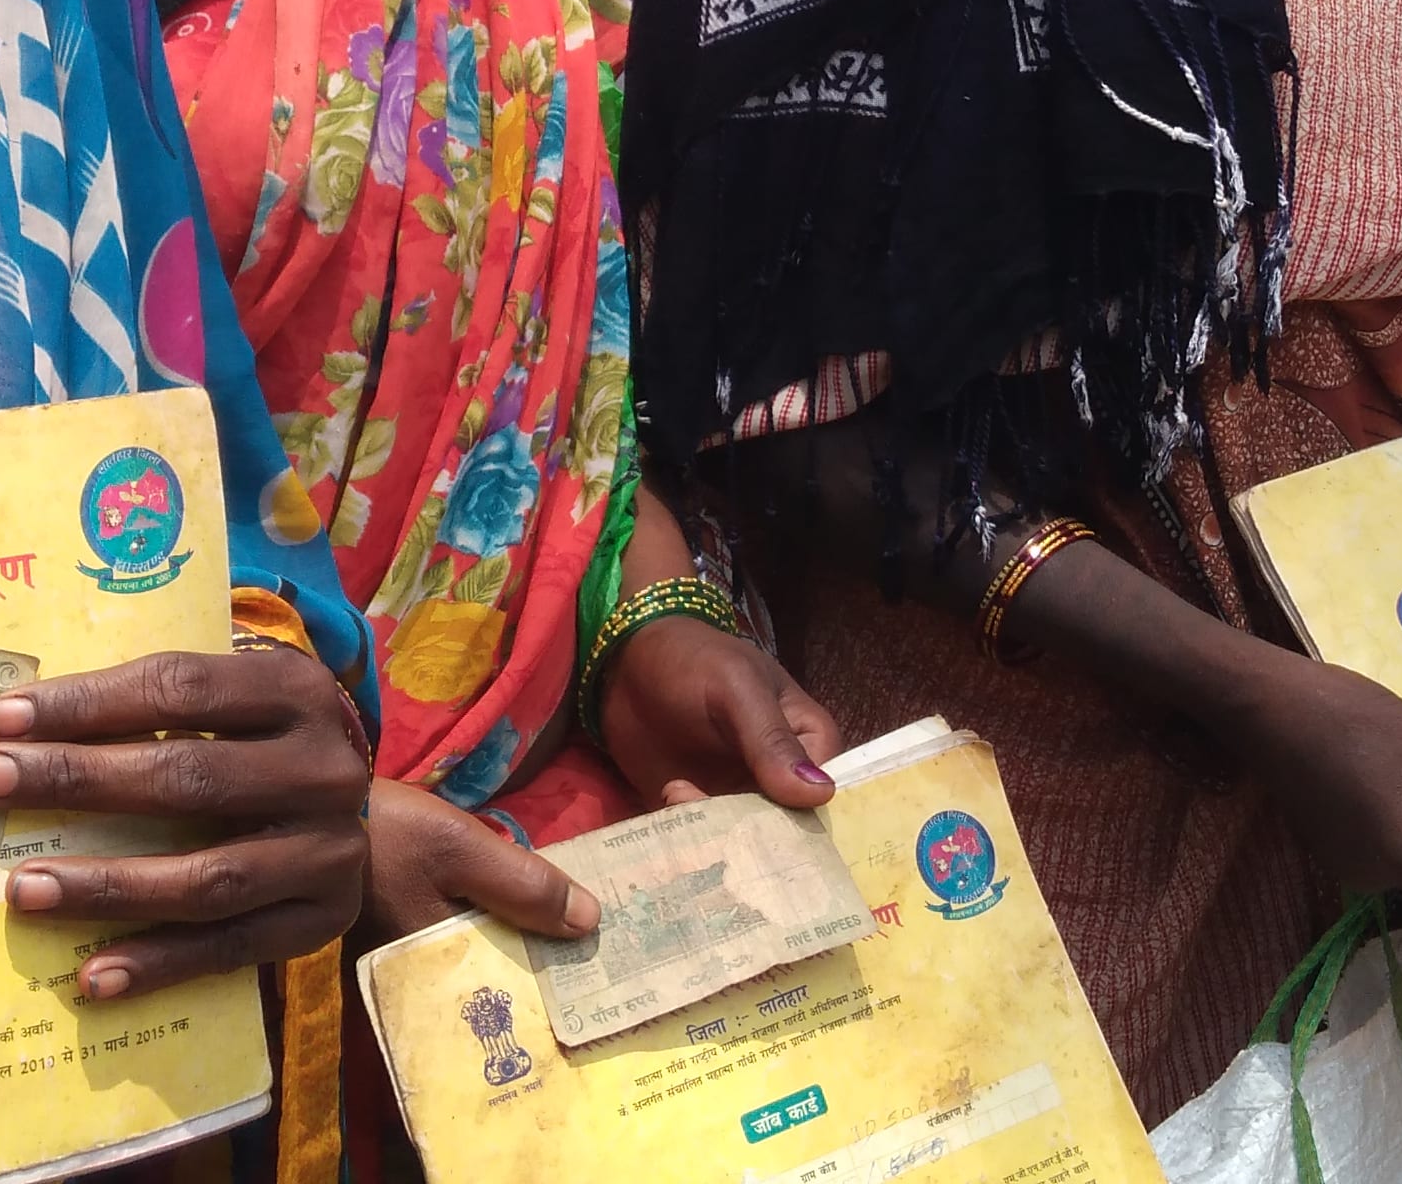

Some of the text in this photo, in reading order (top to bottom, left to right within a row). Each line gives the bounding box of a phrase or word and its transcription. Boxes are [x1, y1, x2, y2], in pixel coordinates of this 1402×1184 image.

[602, 825, 651, 850] भारतीय
[785, 928, 812, 949] FIVE
[814, 914, 862, 939] RUPEES
[28, 978, 40, 992] के
[0, 1027, 15, 1042] की
[21, 1020, 53, 1038] अवधि
[560, 988, 659, 1035] 5 रुपये
[686, 1016, 727, 1046] जिला
[755, 984, 809, 1017] लातेहार
[62, 1047, 74, 1064] से
[81, 1045, 96, 1060] 31
[104, 1031, 129, 1053] मार्च
[136, 1027, 166, 1046] 2015
[170, 1017, 190, 1034] तक
[618, 1102, 629, 1117] के
[633, 1091, 663, 1112] अन्तर्गत
[667, 1076, 704, 1098] संचालित
[707, 1062, 734, 1082] महात्मा
[760, 1040, 787, 1061] राष्ट्रीय
[791, 1028, 817, 1049] ग्रामीण
[820, 1015, 848, 1036] रोजगार
[877, 993, 902, 1013] योजना
[635, 1070, 663, 1088] महात्मा
[690, 1046, 718, 1065] राष्ट्रीय
[721, 1035, 748, 1055] ग्रामीण
[752, 1021, 780, 1041] रोजगार
[810, 994, 849, 1017] अधिनियम
[853, 984, 874, 1000] 2005
[750, 1090, 821, 1135] जॉब कार्ड
[927, 1106, 962, 1128] पंजीकरण
[800, 1161, 837, 1184] ग्राम कोड
